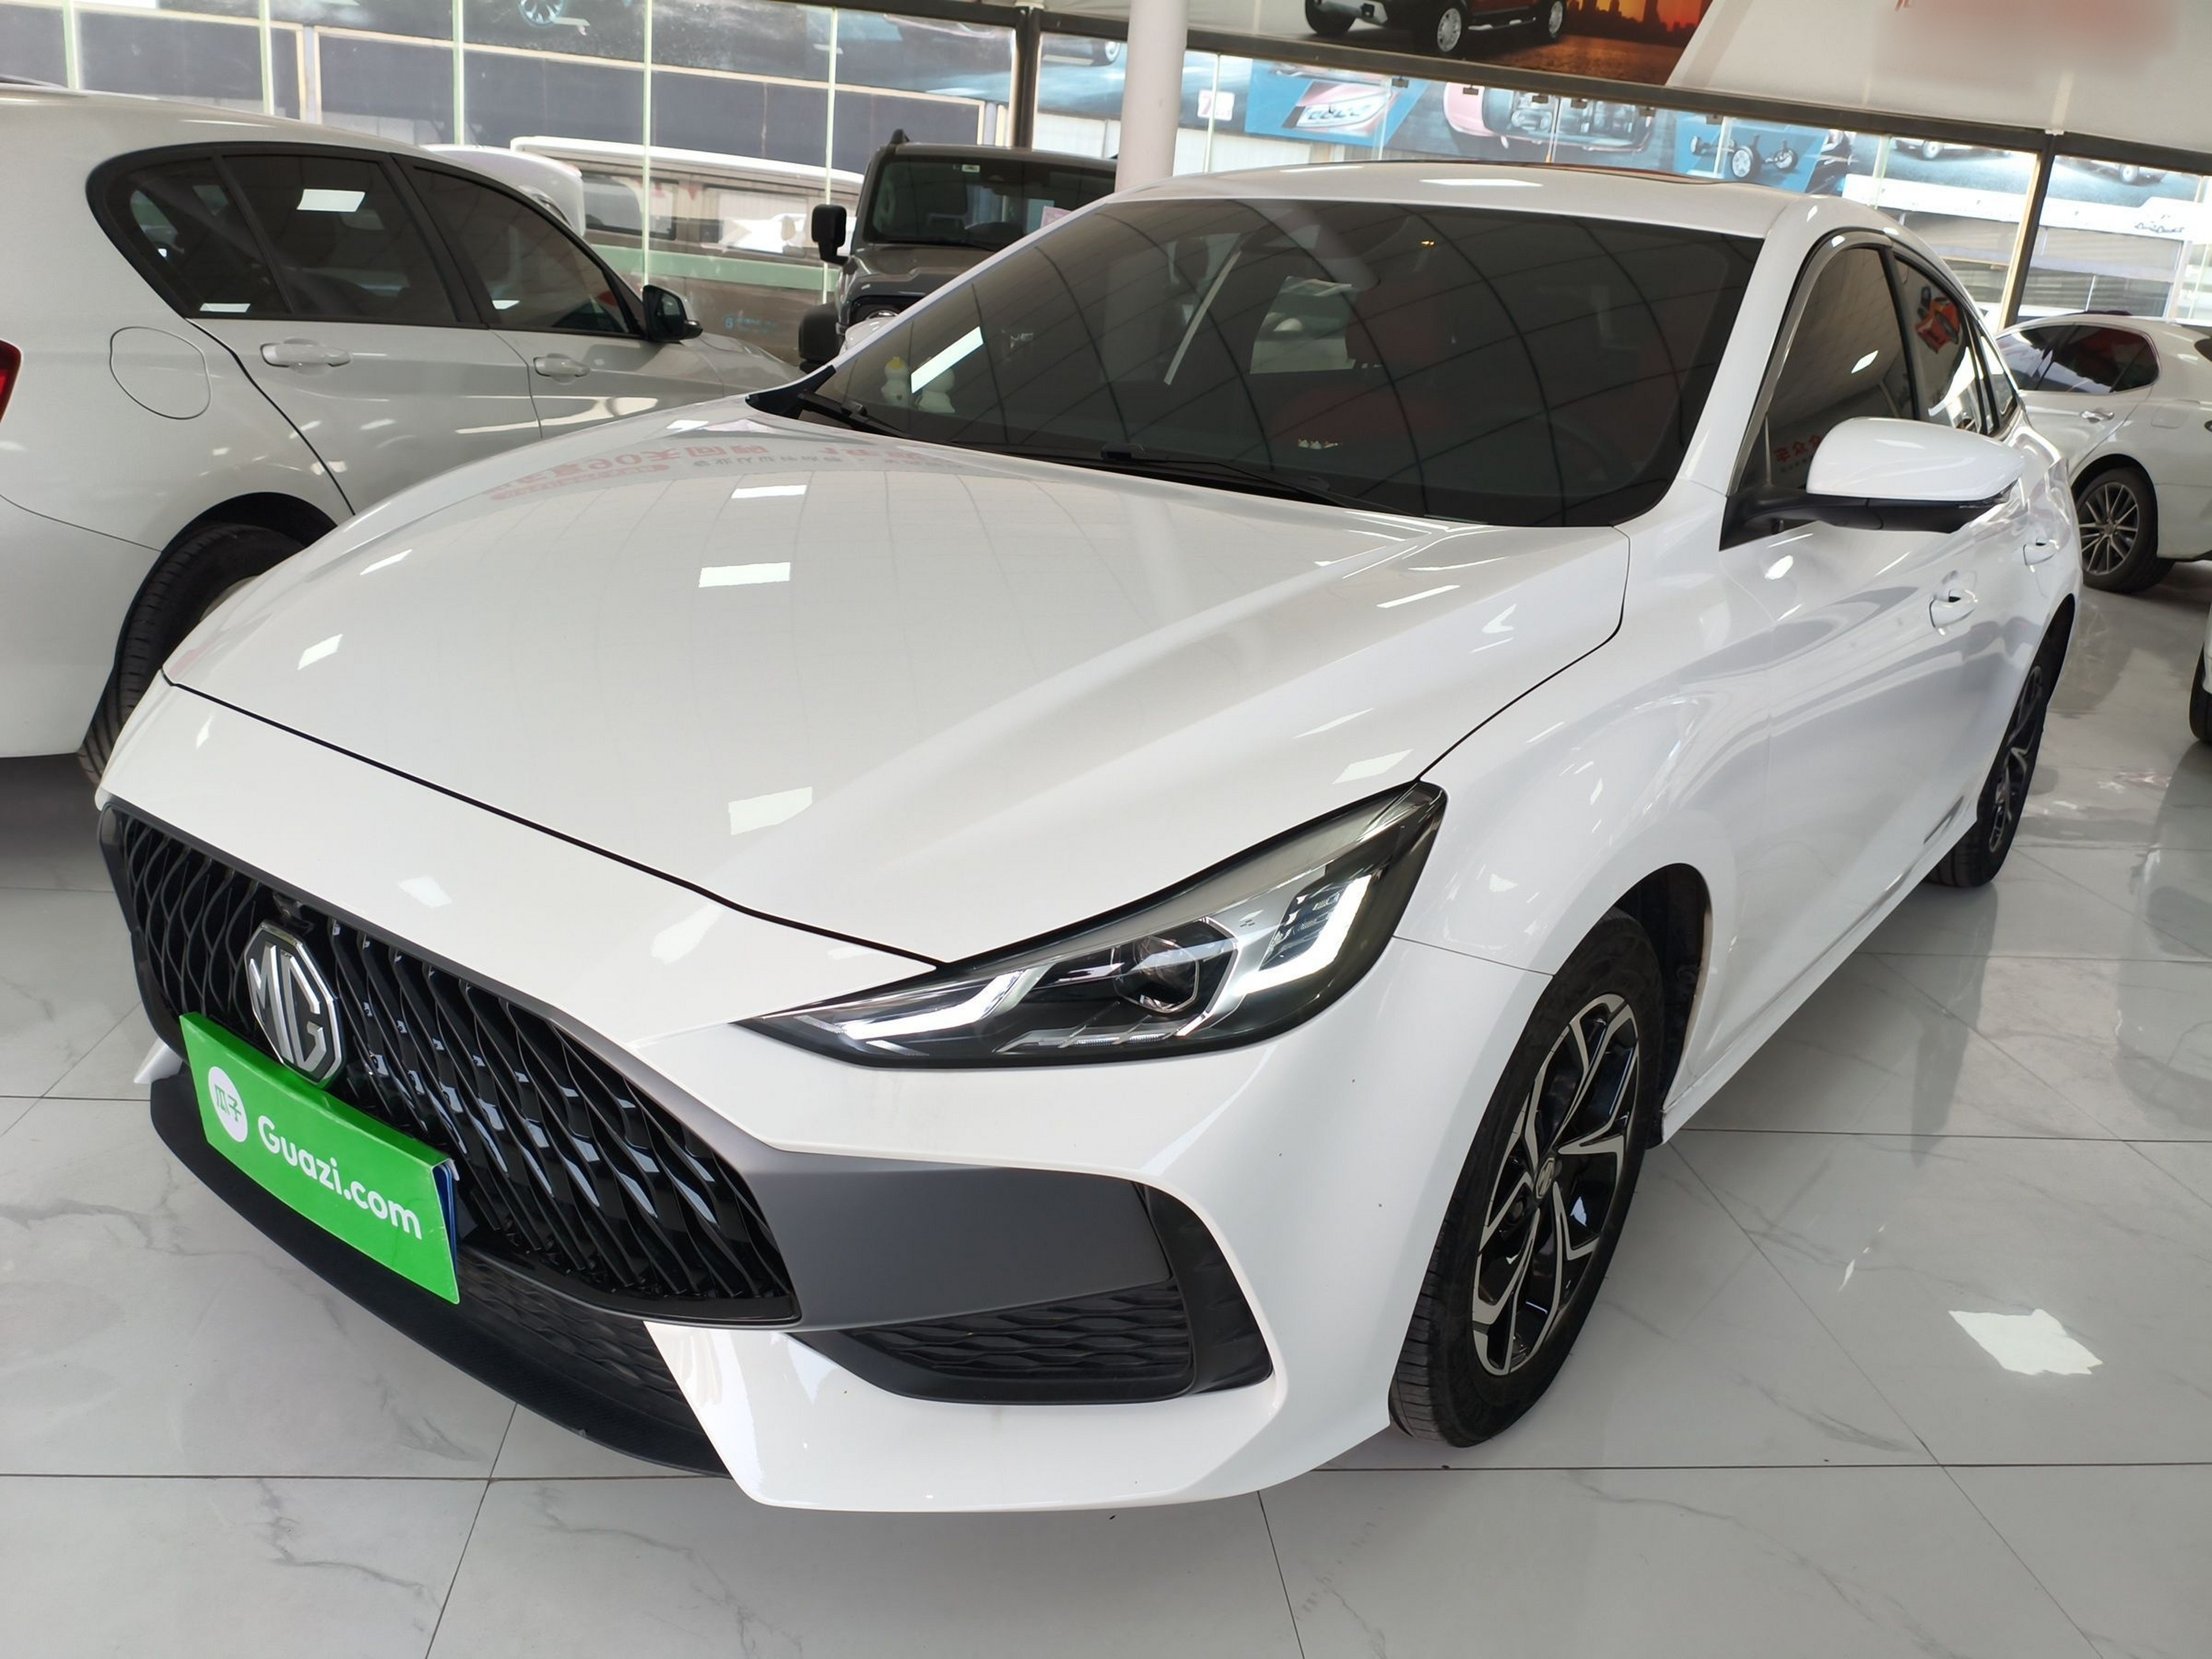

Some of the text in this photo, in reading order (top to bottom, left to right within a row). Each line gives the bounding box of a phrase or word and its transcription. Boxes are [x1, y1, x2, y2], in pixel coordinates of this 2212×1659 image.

[249, 941, 327, 1073] MG
[214, 1083, 242, 1123] 瓜子
[257, 1115, 422, 1240] Guazi.com
